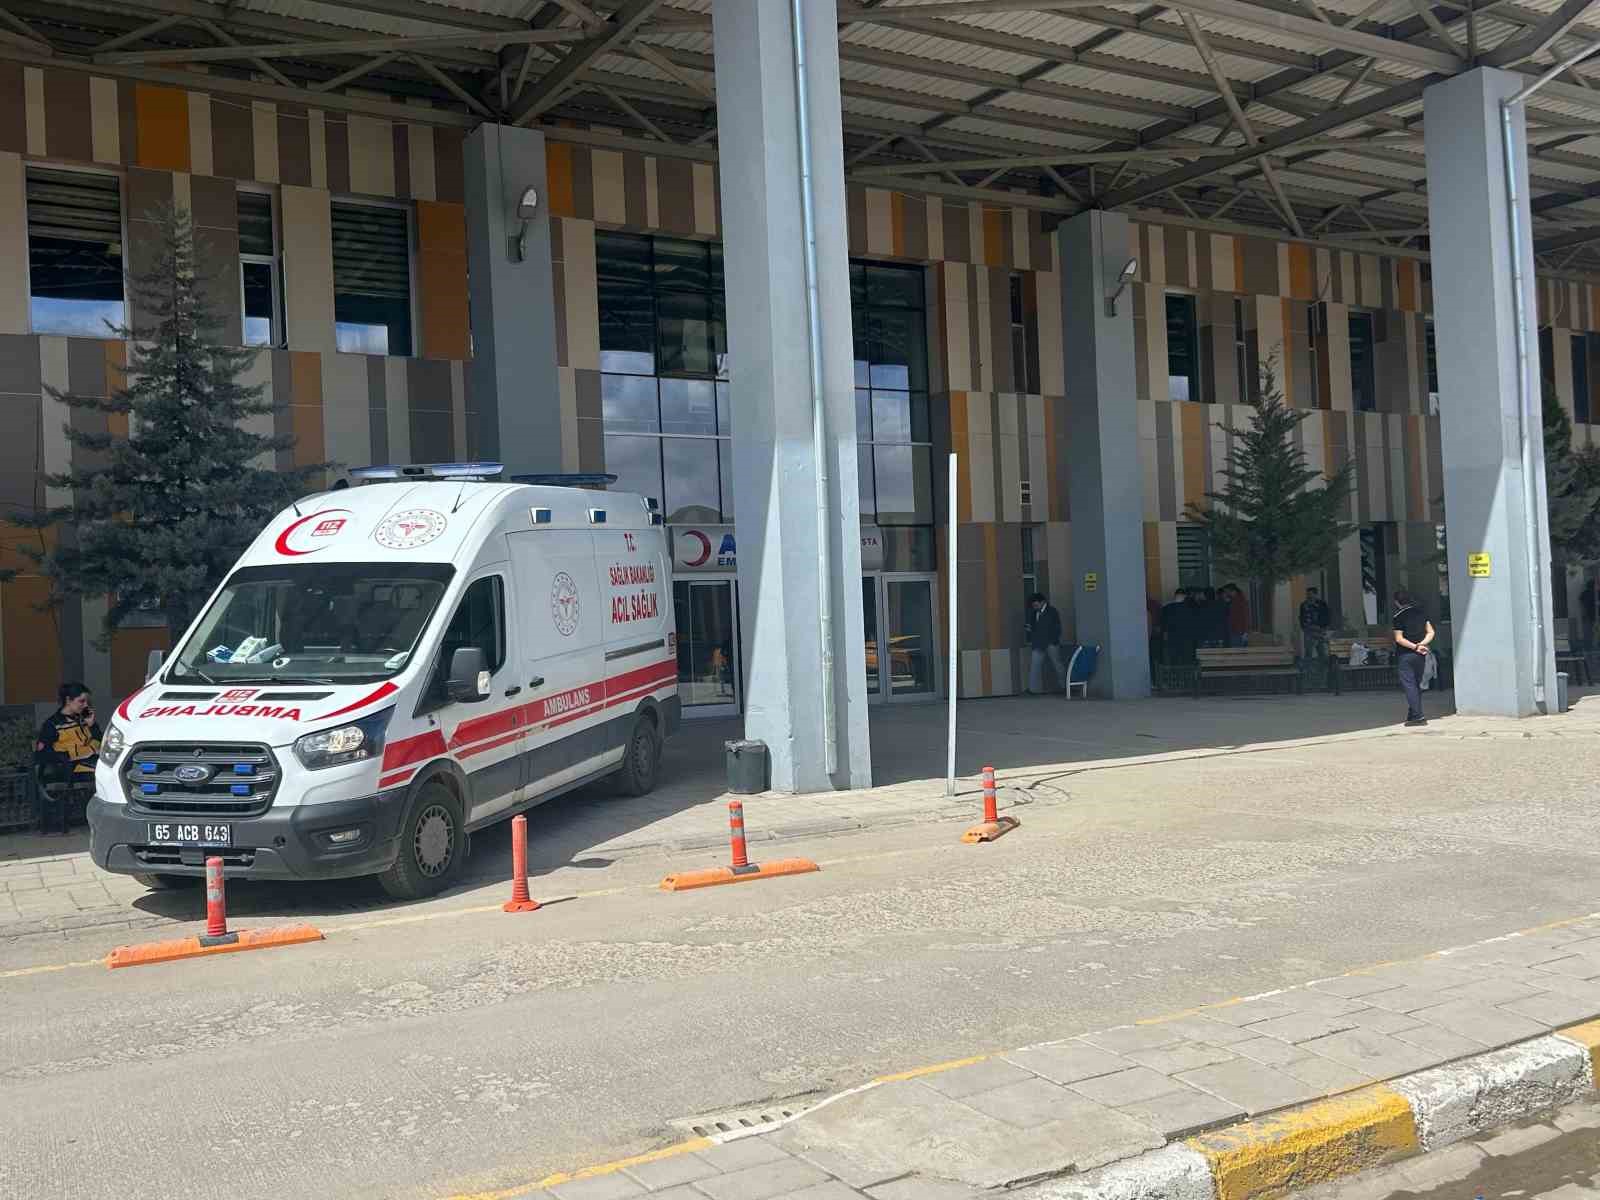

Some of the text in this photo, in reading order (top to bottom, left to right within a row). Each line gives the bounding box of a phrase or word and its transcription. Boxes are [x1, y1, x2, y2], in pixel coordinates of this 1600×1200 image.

[631, 589, 658, 620] SAĞLIK
[544, 688, 591, 718] AMBULANS
[155, 824, 228, 841] 65 ACB 643
